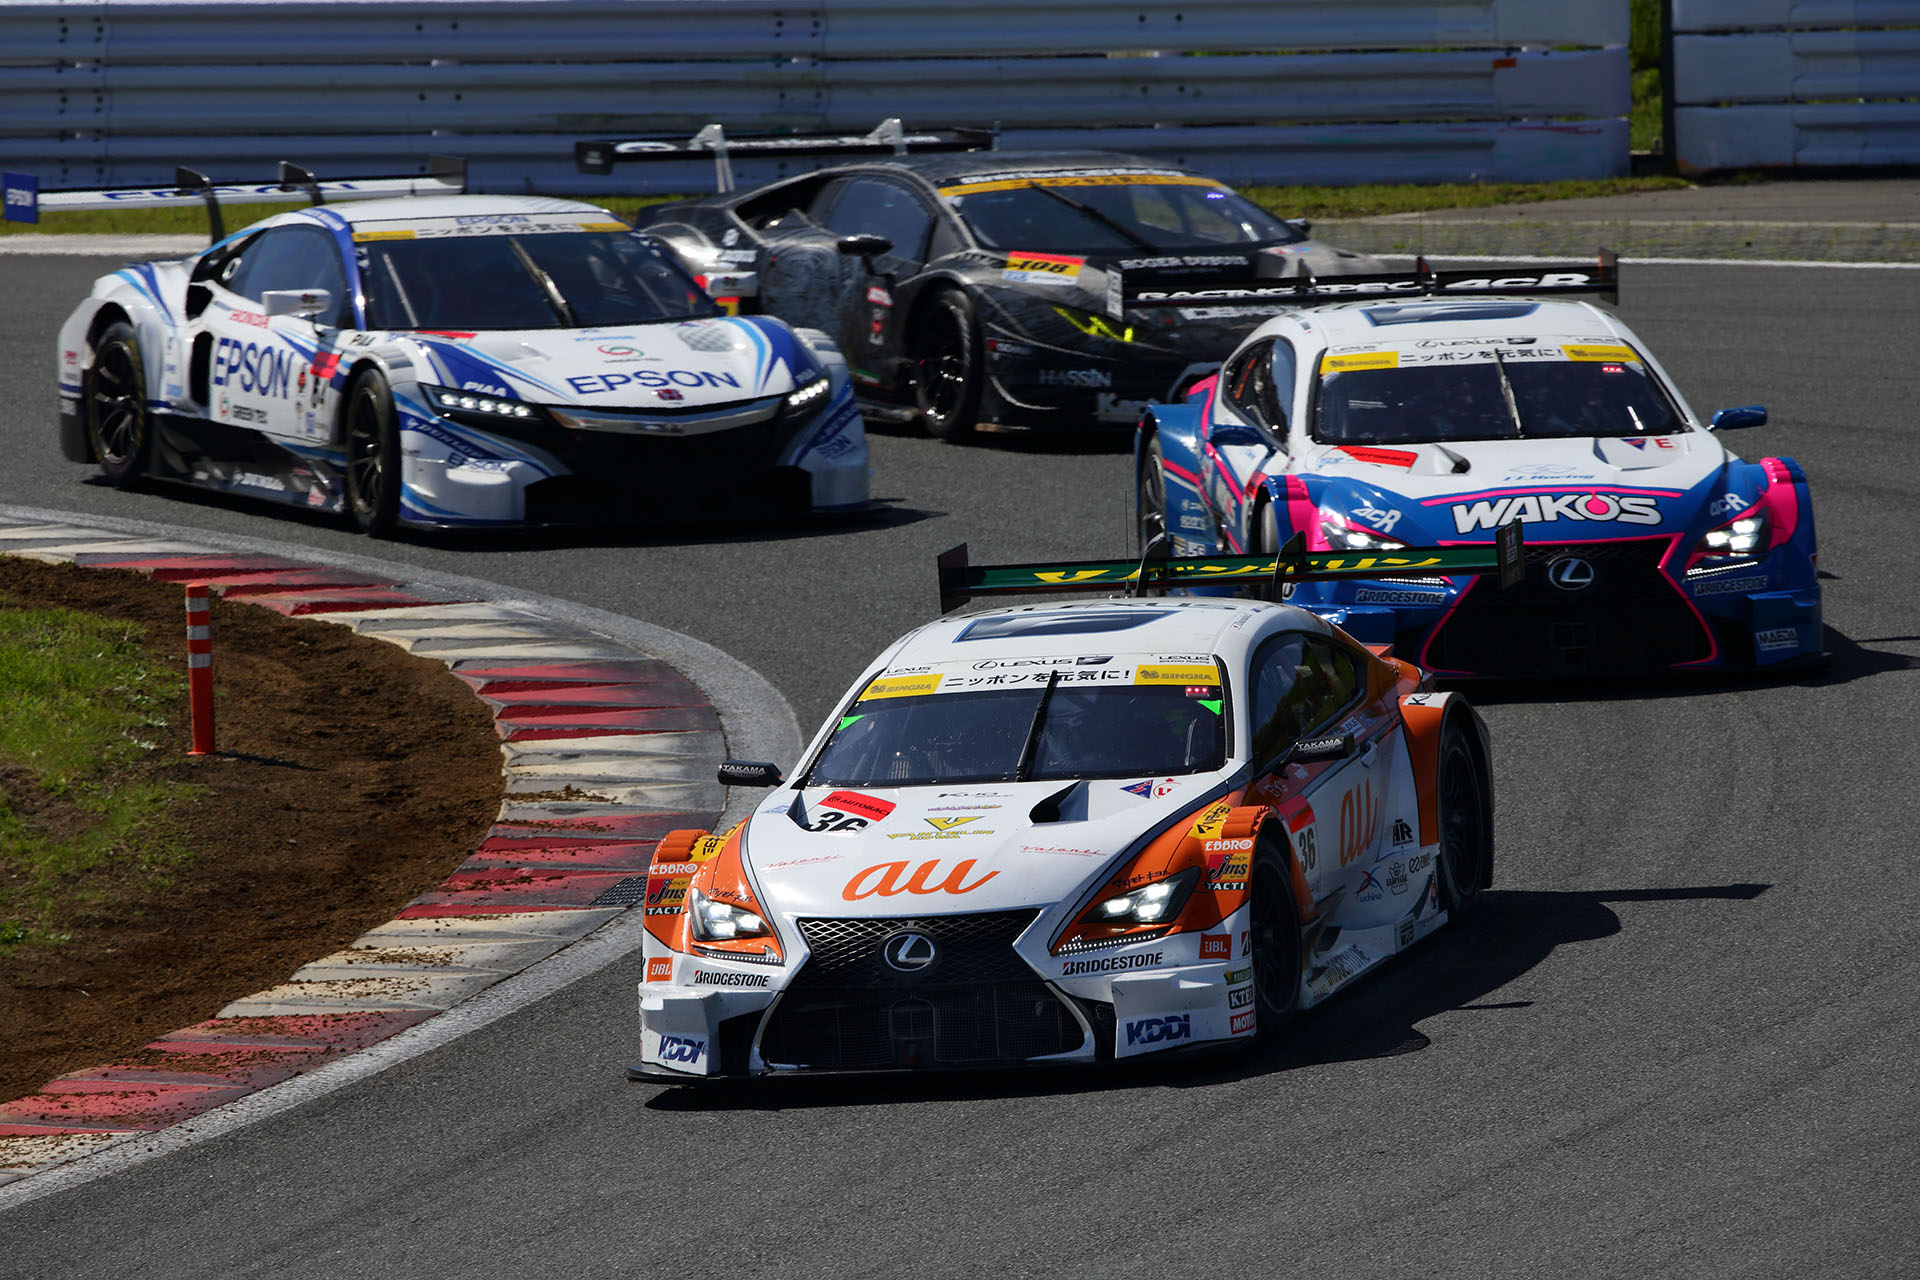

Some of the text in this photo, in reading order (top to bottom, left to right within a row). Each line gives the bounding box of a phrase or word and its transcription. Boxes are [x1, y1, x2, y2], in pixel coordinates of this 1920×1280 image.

[214, 337, 294, 399] EPSON
[462, 381, 508, 398] PIAA
[565, 370, 742, 395] EPSON
[1451, 494, 1664, 535] WAKO'S
[1695, 576, 1768, 596] BRIDGESTONE
[1356, 589, 1447, 604] BRIDGESTONE
[887, 665, 931, 674] LEXUS
[1001, 659, 1072, 667] LEXUS
[1160, 673, 1213, 681] SINGHA
[885, 683, 932, 693] SINGHA
[1340, 778, 1378, 869] au
[886, 828, 996, 840] VANTELIN
[1205, 839, 1253, 851] EBBRO
[1299, 828, 1316, 873] 36
[650, 863, 698, 875] EBBRO
[841, 858, 1002, 901] au
[1206, 882, 1246, 891] TACTI
[647, 905, 684, 916] TACTI
[1205, 940, 1228, 953] JBL
[651, 960, 671, 976] JBL
[1062, 952, 1164, 976] BRIDGESTONE
[694, 970, 771, 987] BRIDGESTONE
[1126, 1013, 1191, 1047] KDDI
[658, 1035, 706, 1065] KDDI
